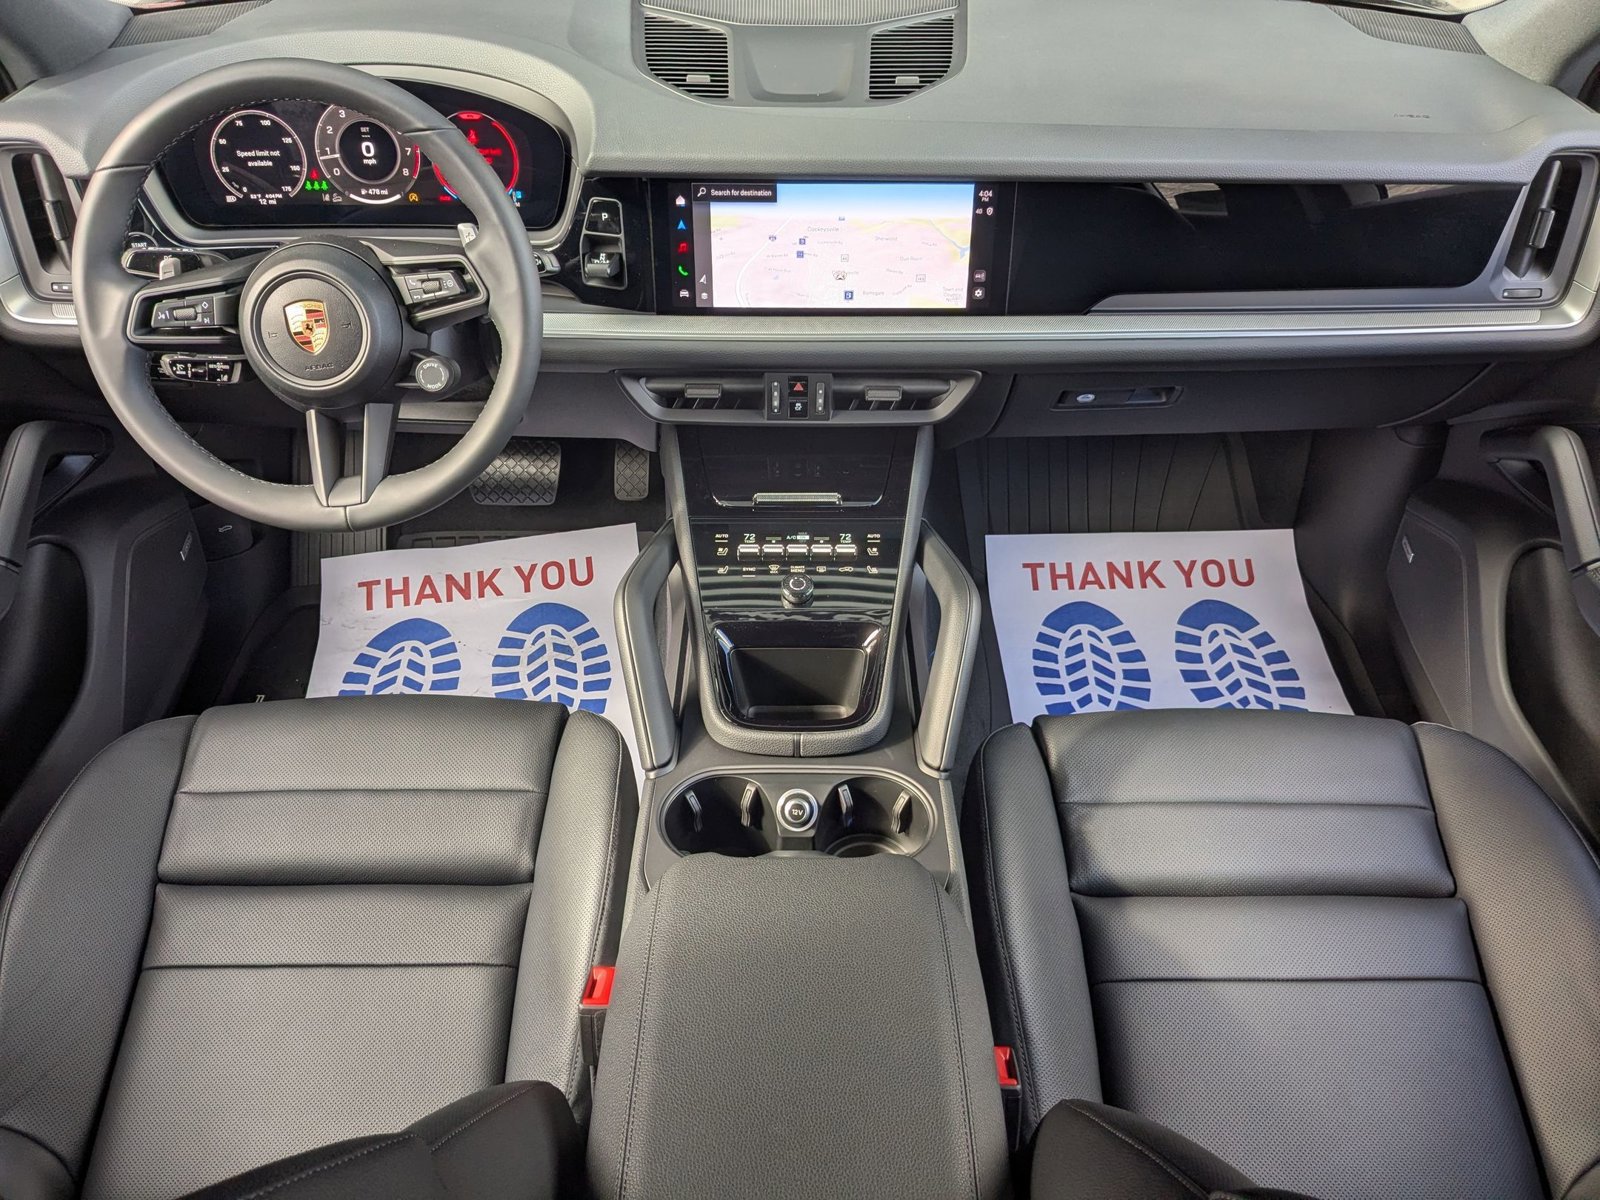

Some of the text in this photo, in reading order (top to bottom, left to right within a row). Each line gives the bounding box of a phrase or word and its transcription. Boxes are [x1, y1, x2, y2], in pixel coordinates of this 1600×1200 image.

[339, 109, 346, 118] 3
[326, 126, 333, 134] 2
[361, 141, 375, 157] 0
[404, 147, 411, 156] 7
[236, 150, 255, 158] Speed
[333, 168, 341, 176] 0
[402, 168, 409, 176] 8
[601, 213, 609, 221] P
[423, 362, 439, 370] DRIVE
[743, 533, 756, 541] 72
[839, 533, 852, 541] 72
[1022, 558, 1255, 591] THANK YOU
[357, 556, 594, 611] THANK YOU
[791, 808, 804, 816] 12V
